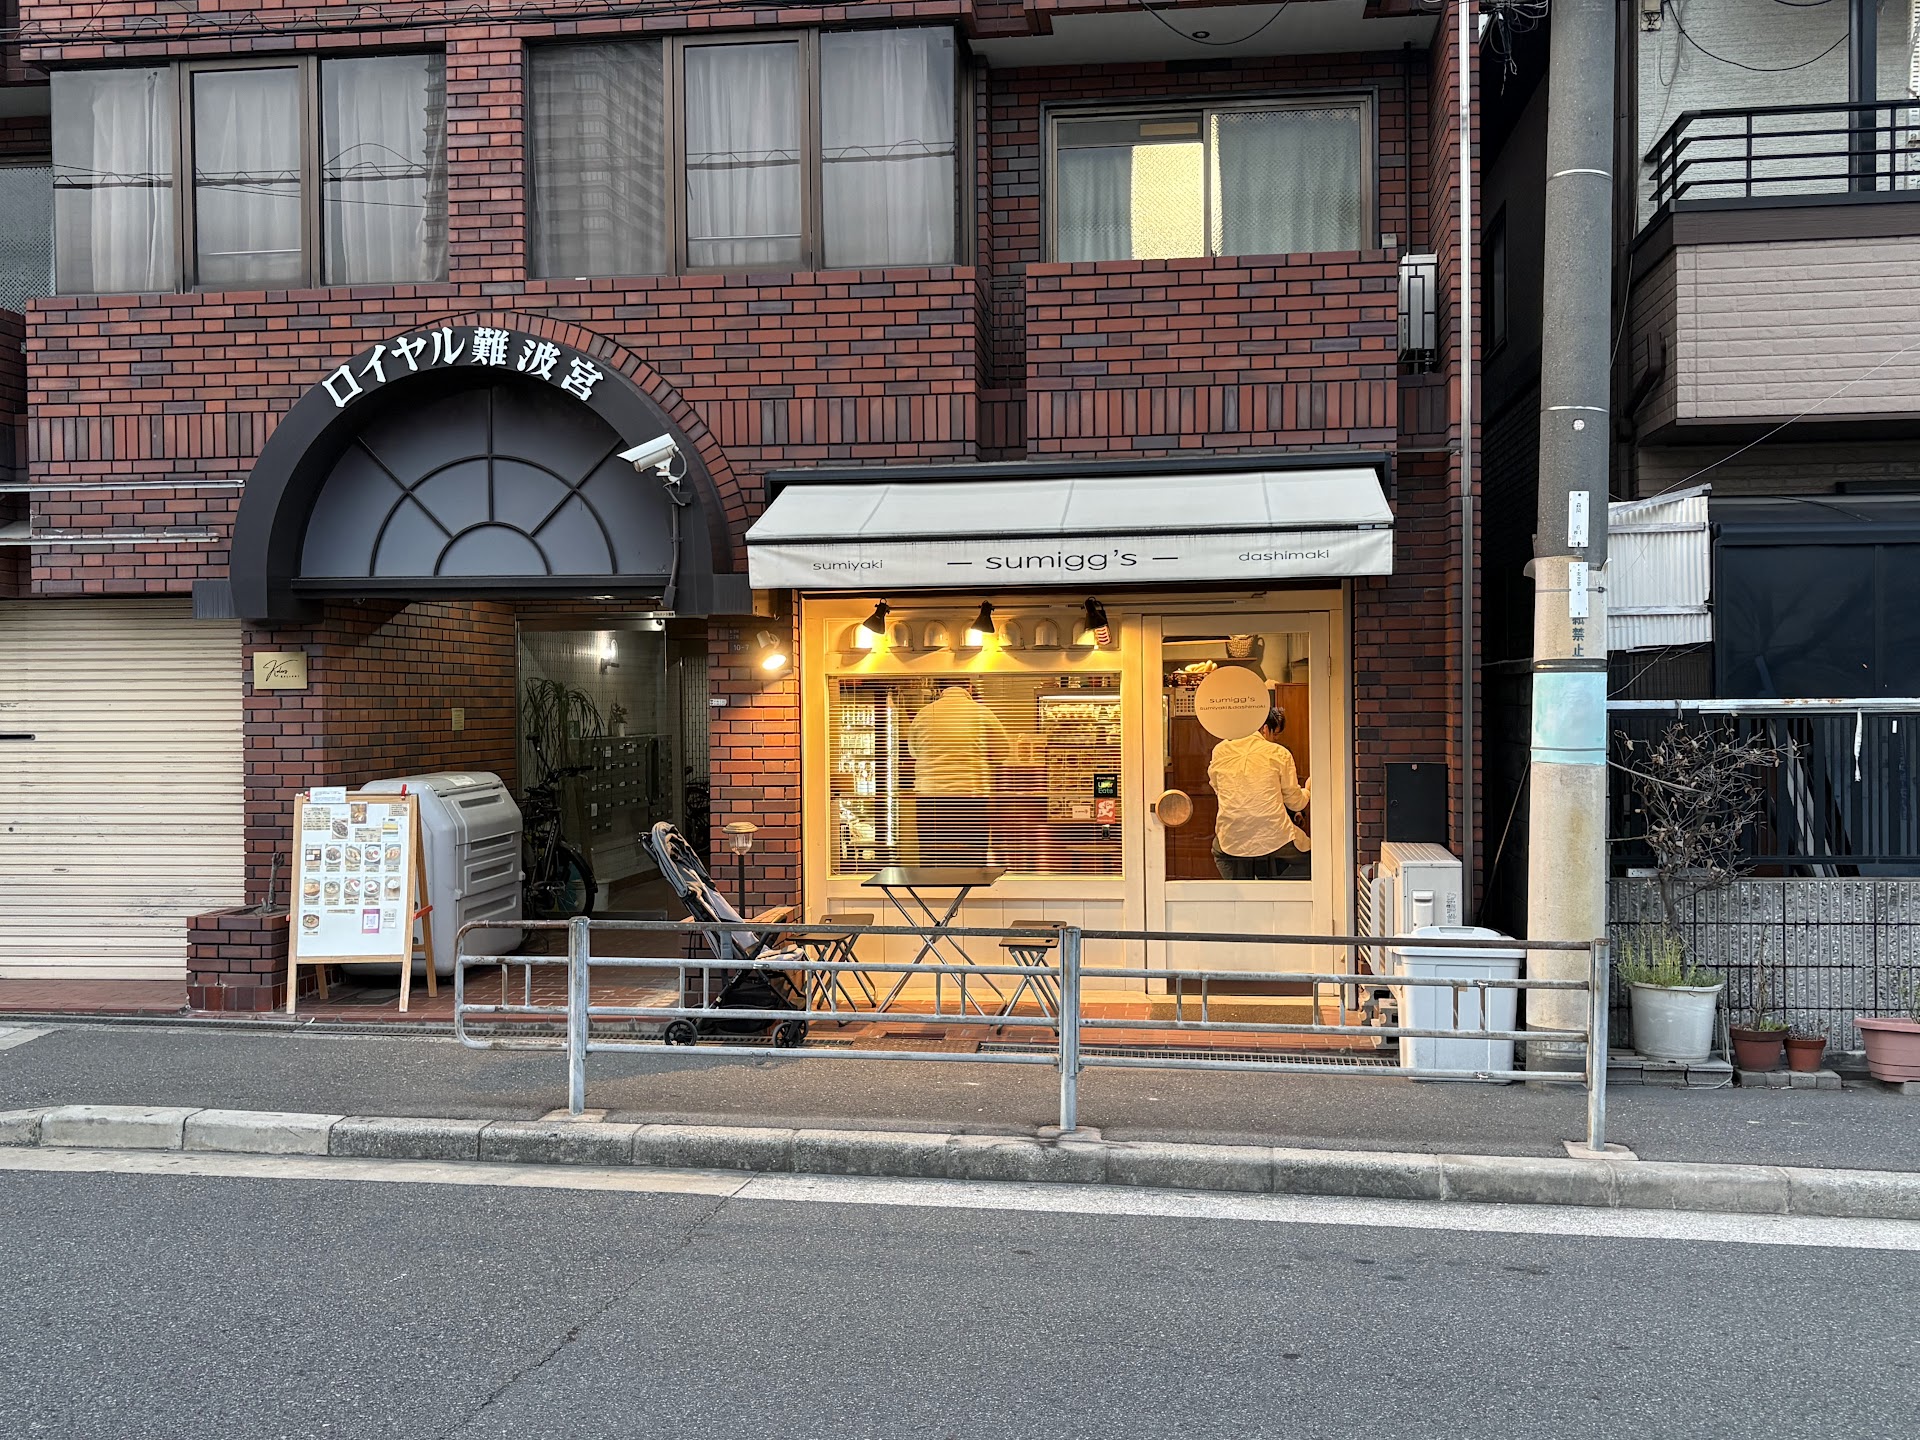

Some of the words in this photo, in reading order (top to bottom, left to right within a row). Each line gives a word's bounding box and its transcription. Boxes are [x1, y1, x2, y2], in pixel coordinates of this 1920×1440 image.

[321, 326, 604, 408] ロイヤル難波宮
[985, 549, 1137, 571] sumigg's
[1238, 549, 1329, 562] dashimaki
[813, 559, 883, 571] sumiyaki
[1209, 696, 1256, 704] sumigg's
